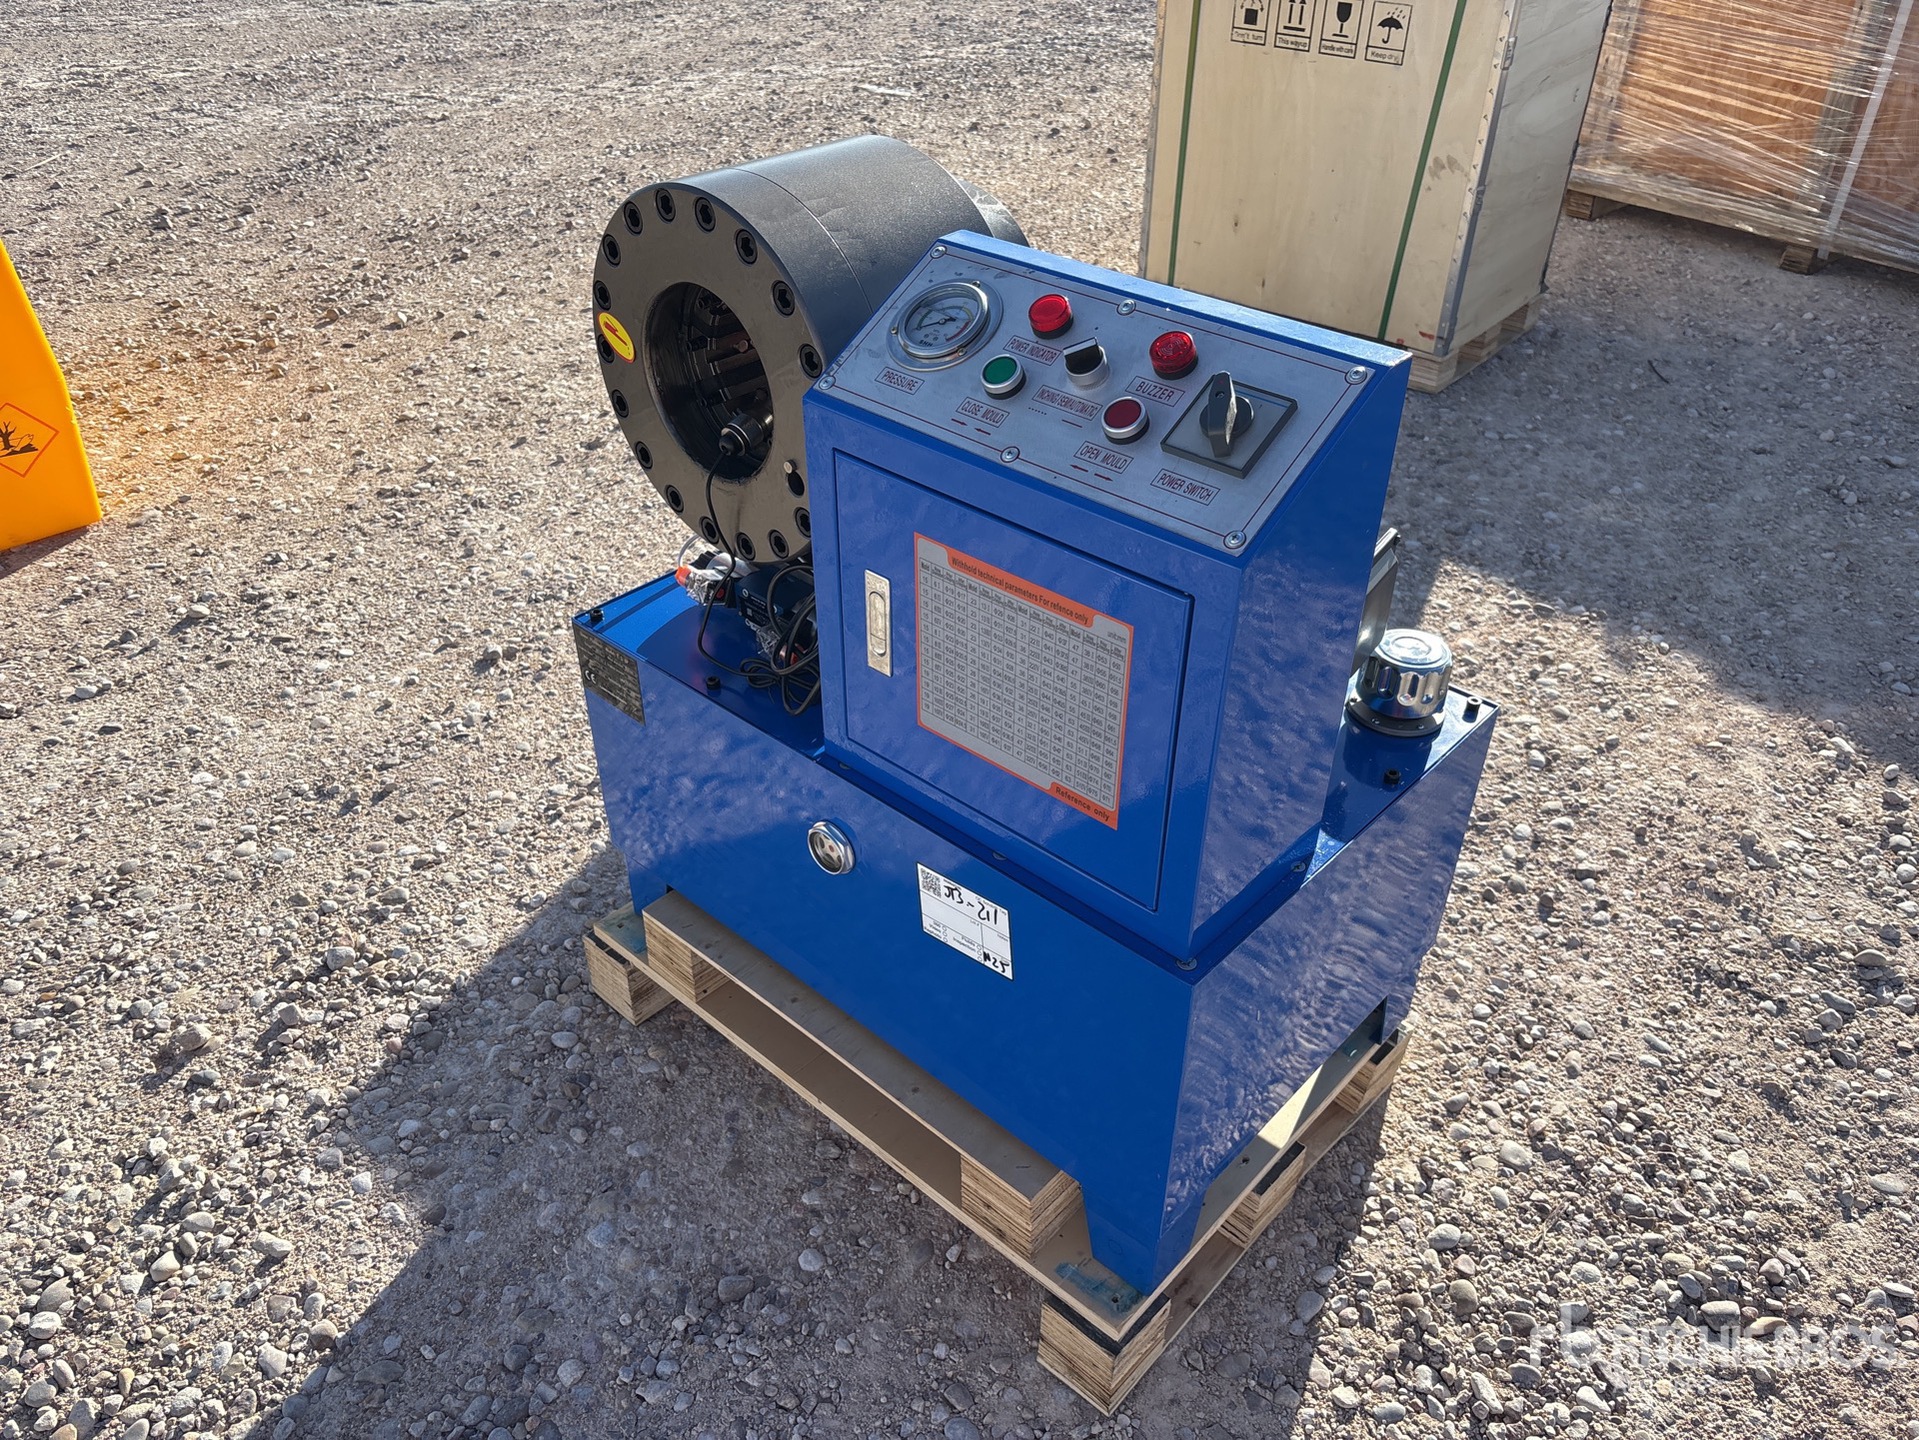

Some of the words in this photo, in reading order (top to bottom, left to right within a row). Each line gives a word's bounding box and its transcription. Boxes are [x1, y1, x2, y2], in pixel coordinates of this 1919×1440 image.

[1278, 37, 1289, 45] This
[1371, 51, 1387, 59] Keep
[1008, 339, 1030, 354] POWER
[1028, 344, 1058, 363] INDICATOR
[881, 371, 918, 391] PRESSURE
[1136, 382, 1175, 401] BUZZER
[961, 401, 983, 416] CLOSE
[981, 408, 1005, 424] MOULD
[1080, 446, 1099, 461] OPEN
[1101, 453, 1127, 470] MOULD
[1157, 474, 1185, 490] POWER
[1184, 483, 1213, 501] SWITCH
[952, 556, 977, 576] Withhold
[977, 566, 1004, 586] technical
[1004, 577, 1039, 602] parameters
[1039, 595, 1050, 606] For
[1074, 612, 1088, 625] only
[585, 670, 596, 684] CE
[1055, 787, 1092, 810] Reference
[1094, 808, 1110, 822] only
